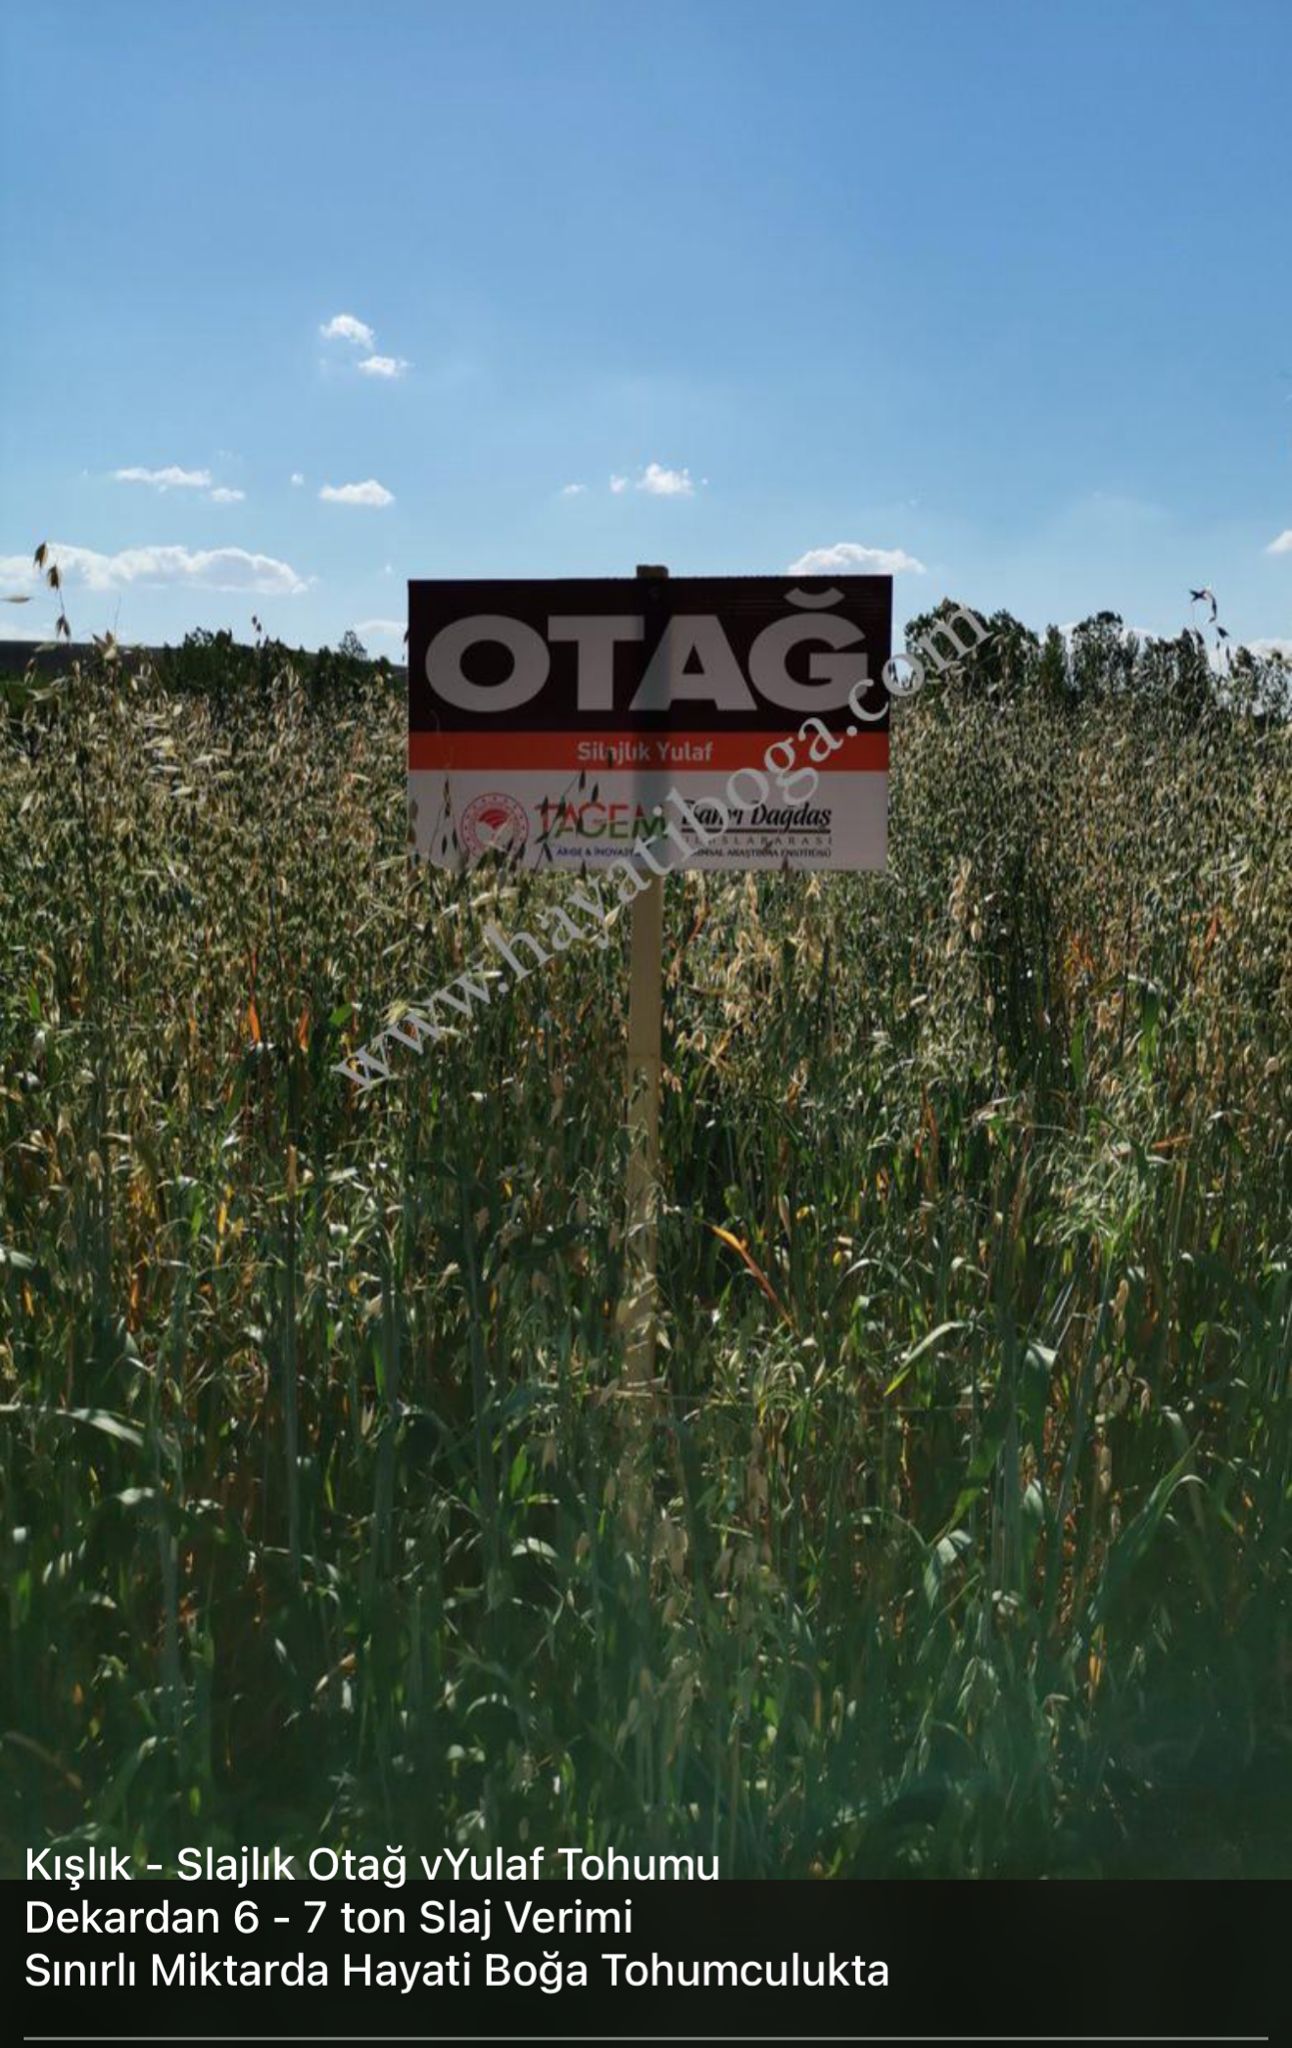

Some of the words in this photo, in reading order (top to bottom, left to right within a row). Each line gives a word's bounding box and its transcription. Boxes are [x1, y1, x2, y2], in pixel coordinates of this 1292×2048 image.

[425, 587, 868, 713] OTAĞ
[656, 741, 714, 761] Yulaf
[534, 801, 669, 840] TAGEM
